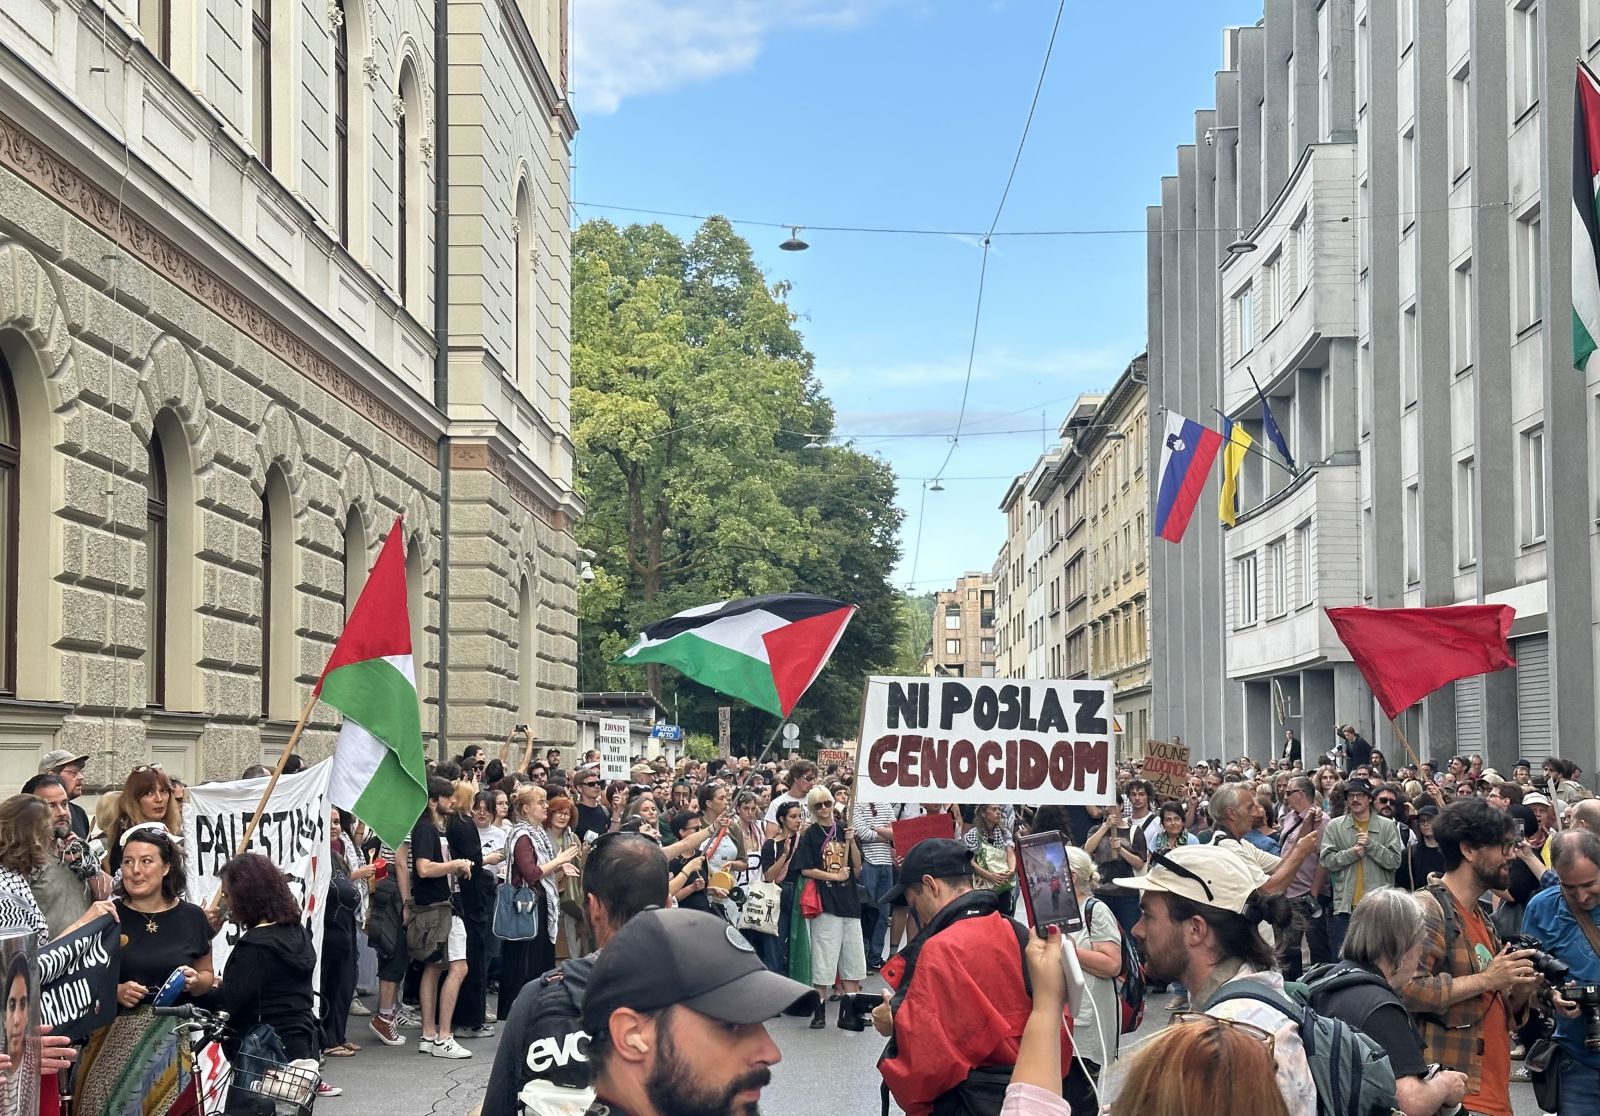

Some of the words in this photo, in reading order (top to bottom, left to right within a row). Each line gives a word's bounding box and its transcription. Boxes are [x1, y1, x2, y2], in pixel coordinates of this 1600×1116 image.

[887, 682, 929, 729] NI
[940, 682, 1069, 733] POSLA
[1073, 689, 1108, 734] Z
[604, 723, 626, 732] ZIONIST
[655, 725, 677, 733] POZOR
[600, 736, 626, 744] TOURISTS
[1149, 742, 1188, 761] VOJNE
[868, 734, 1108, 795] GENOCIDOM
[1154, 773, 1171, 785] ZA
